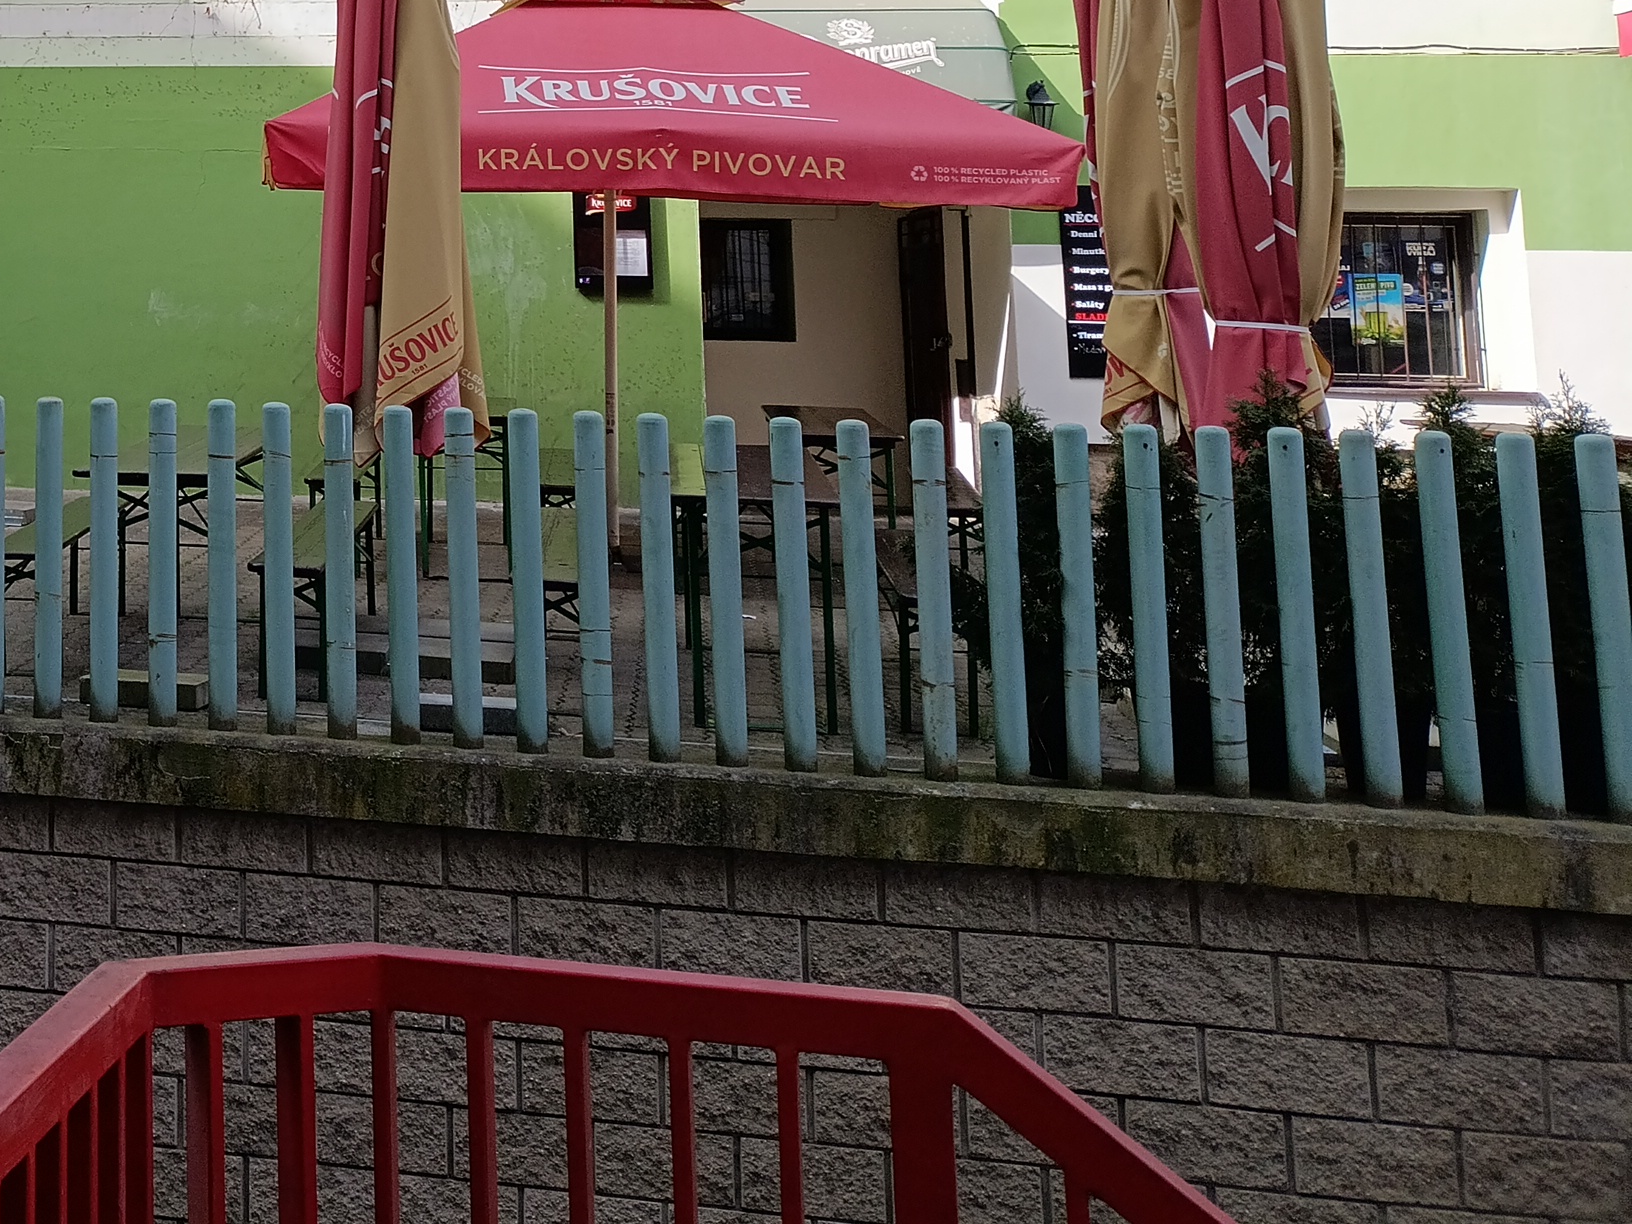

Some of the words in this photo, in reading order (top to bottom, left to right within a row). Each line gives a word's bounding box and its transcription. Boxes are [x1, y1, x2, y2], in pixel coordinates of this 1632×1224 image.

[844, 37, 945, 68] pramen
[500, 74, 811, 108] KRUŠOVICE
[633, 99, 673, 107] 1581
[478, 143, 680, 171] KRÁLOVSKÝ
[692, 149, 846, 180] PIVOVAR
[933, 166, 950, 174] 100
[960, 167, 1008, 176] RECYCLED
[960, 176, 1029, 185] RECYKLOVANÝ
